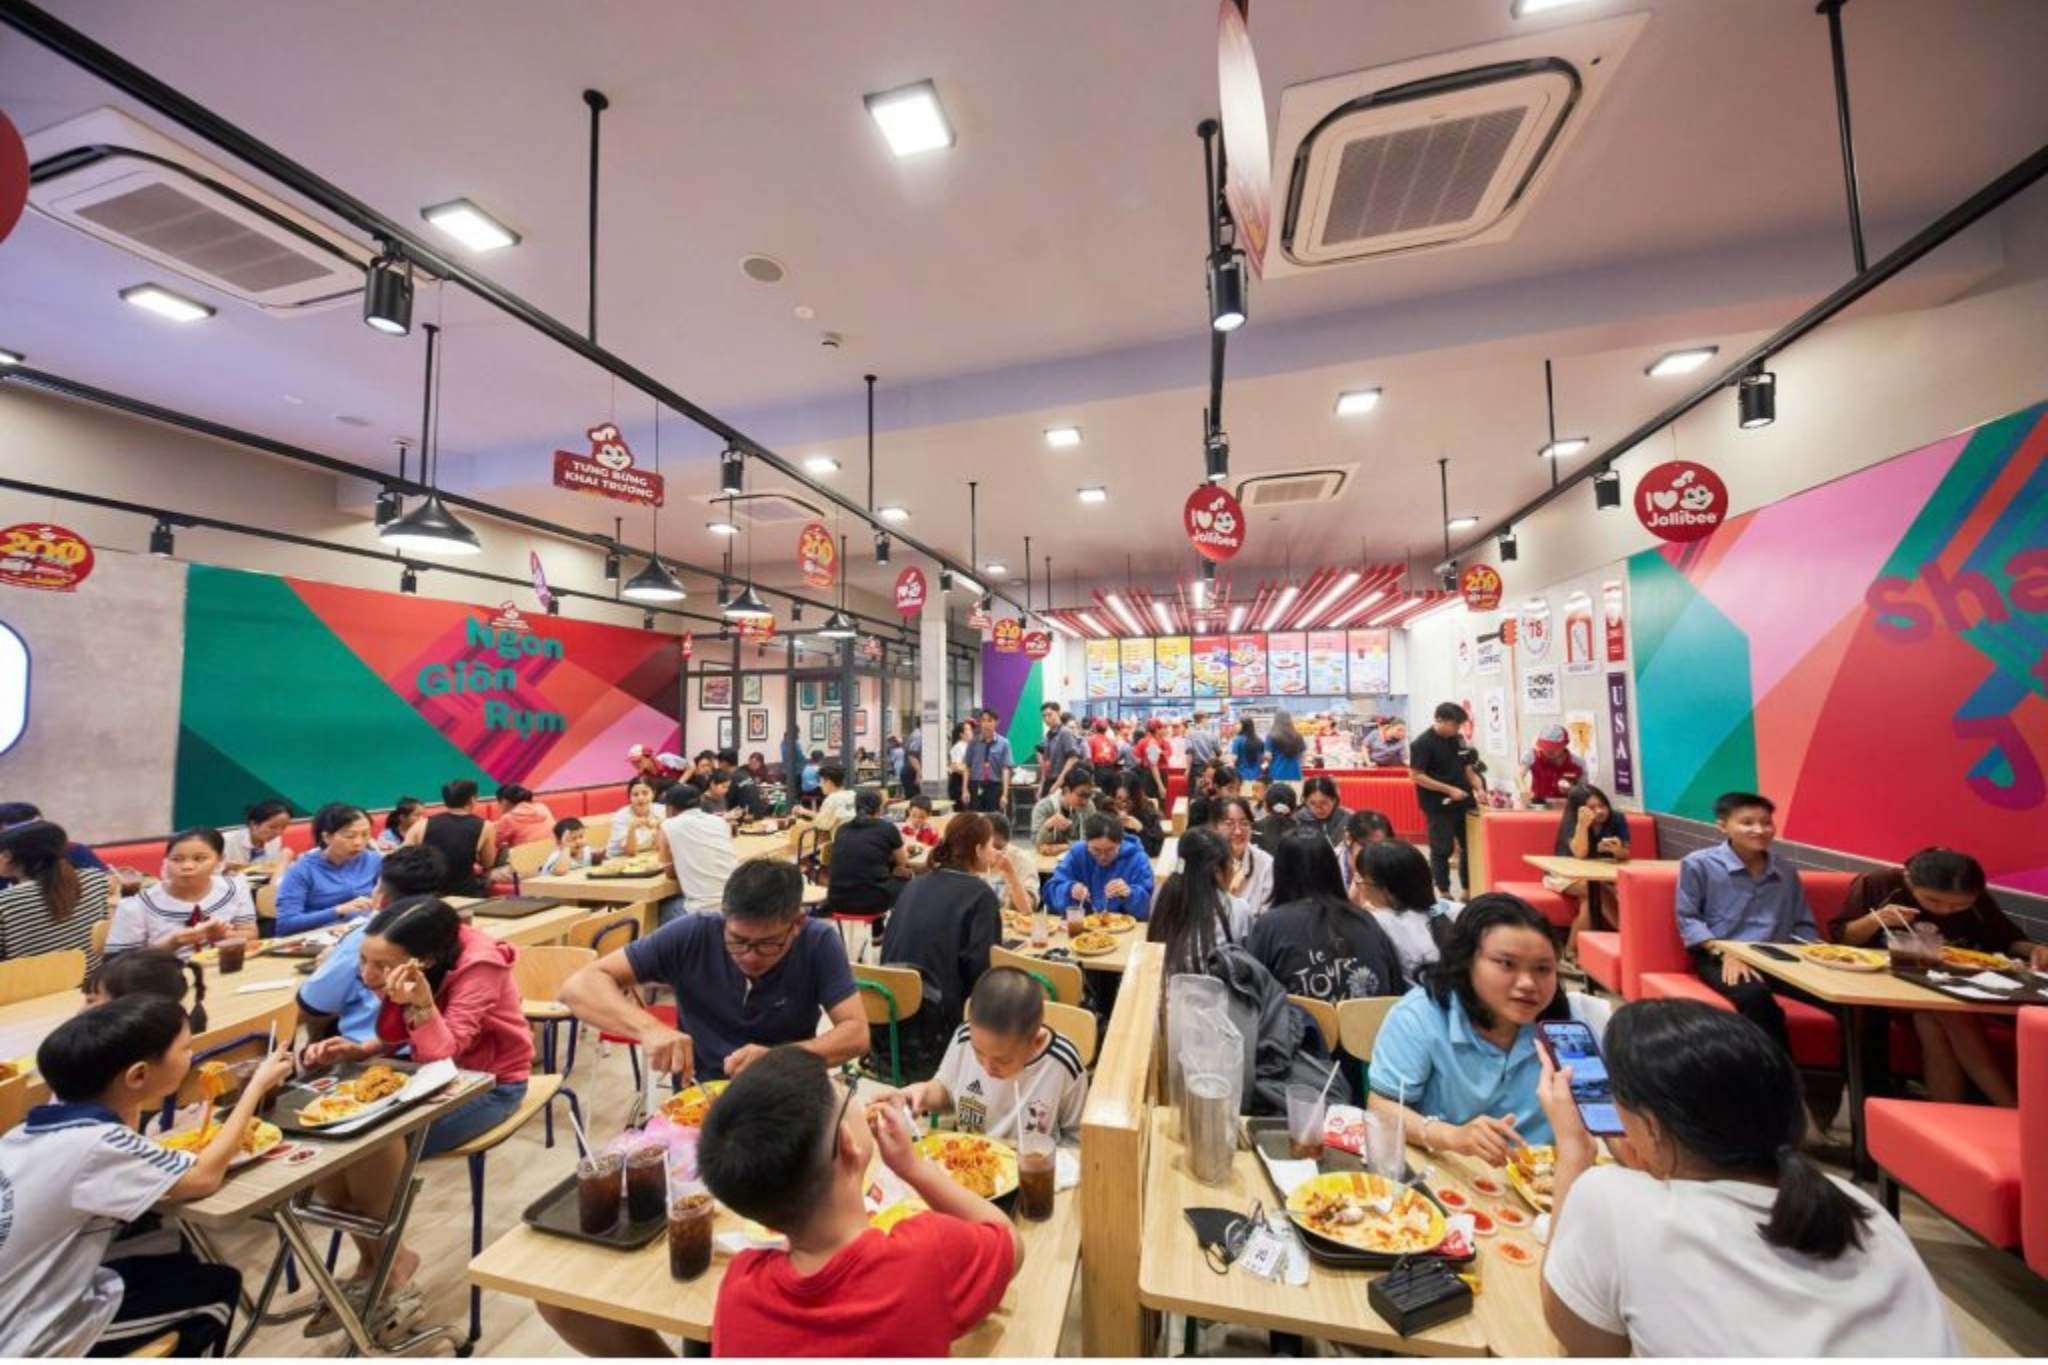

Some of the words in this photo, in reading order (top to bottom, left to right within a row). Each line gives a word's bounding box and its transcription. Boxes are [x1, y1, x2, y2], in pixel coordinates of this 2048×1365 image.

[1647, 510, 1718, 527] Jollibee
[465, 614, 565, 660] Ngon
[416, 659, 517, 697] Giòn
[1611, 685, 1628, 760] USA
